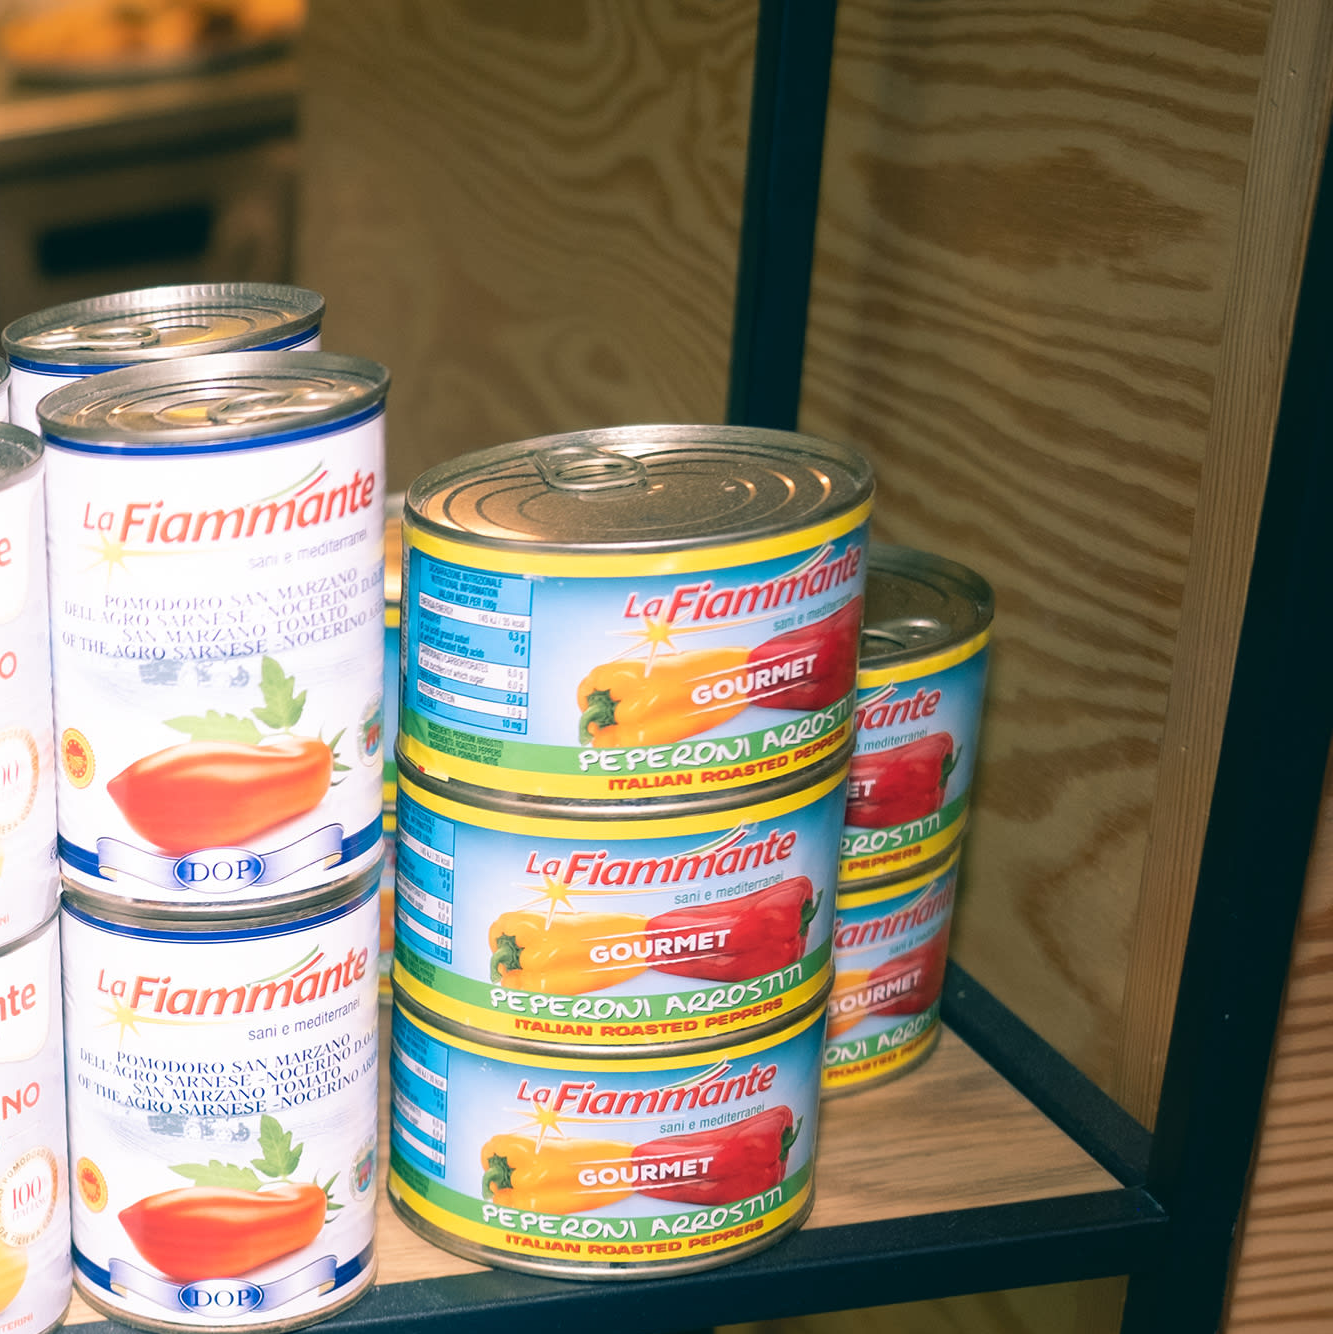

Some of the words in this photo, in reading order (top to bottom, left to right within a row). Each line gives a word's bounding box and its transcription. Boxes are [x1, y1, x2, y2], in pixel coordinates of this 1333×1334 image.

[83, 501, 113, 532] La
[119, 469, 376, 543] Fiammante
[248, 553, 278, 570] sani
[284, 552, 293, 563] e
[104, 593, 223, 612] POMODORO
[231, 591, 269, 606] SAN
[278, 566, 358, 600] MARZANO
[624, 591, 661, 620] La
[664, 544, 862, 625] Fiammante
[122, 627, 158, 643] SAN
[166, 623, 267, 643] MARZANO
[276, 604, 348, 635] TOMATO
[79, 635, 108, 655] THE
[113, 644, 167, 661] AGRO
[173, 640, 269, 661] SARNESE
[691, 653, 817, 706] GOURMET
[579, 739, 750, 773] PEPERONI
[608, 772, 692, 793] ITALIAN
[700, 755, 789, 784] ROASTED
[793, 725, 846, 763] PEPPERS
[863, 728, 928, 752] mediterranei
[189, 858, 252, 884] DOP
[526, 850, 561, 880] La
[563, 827, 797, 887] Fiammante
[848, 844, 922, 872] PEPPERS
[674, 889, 701, 904] sani
[704, 891, 712, 901] e
[716, 869, 785, 901] mediterranei
[589, 928, 731, 964] GOURMET
[97, 967, 126, 998] La
[129, 945, 369, 1017] Fiammante
[490, 987, 653, 1020] PEPERONI
[665, 962, 804, 1016] ARROSTITI
[248, 1026, 278, 1041] sani
[282, 1024, 290, 1036] e
[294, 997, 360, 1034] mediterranei
[514, 1018, 597, 1037] ITALIAN
[601, 1017, 699, 1039] ROASTED
[704, 998, 784, 1029] PEPPERS
[116, 1050, 225, 1075] POMODORO
[232, 1058, 268, 1074] SAN
[275, 1032, 351, 1069] MARZANO
[77, 1073, 92, 1091] OF
[93, 1080, 122, 1105] THE
[124, 1096, 173, 1115] AGRO
[179, 1099, 268, 1118] SARNESE
[133, 1082, 166, 1100] SAN
[172, 1086, 266, 1102] MARZANO
[271, 1065, 342, 1097] TOMATO
[164, 1073, 252, 1089] SARNESE
[516, 1078, 551, 1105] La
[553, 1060, 778, 1116] Fiammante
[659, 1119, 685, 1134] sani
[688, 1120, 696, 1131] e
[699, 1102, 765, 1131] mediterranei
[578, 1155, 715, 1188] GOURMET
[482, 1203, 638, 1240] PEPERONI
[651, 1186, 784, 1237] ARROSTITI
[505, 1233, 581, 1253] ITALIAN
[588, 1236, 681, 1257] ROASTED
[686, 1218, 764, 1250] PEPPERS
[191, 1287, 252, 1309] DOP
